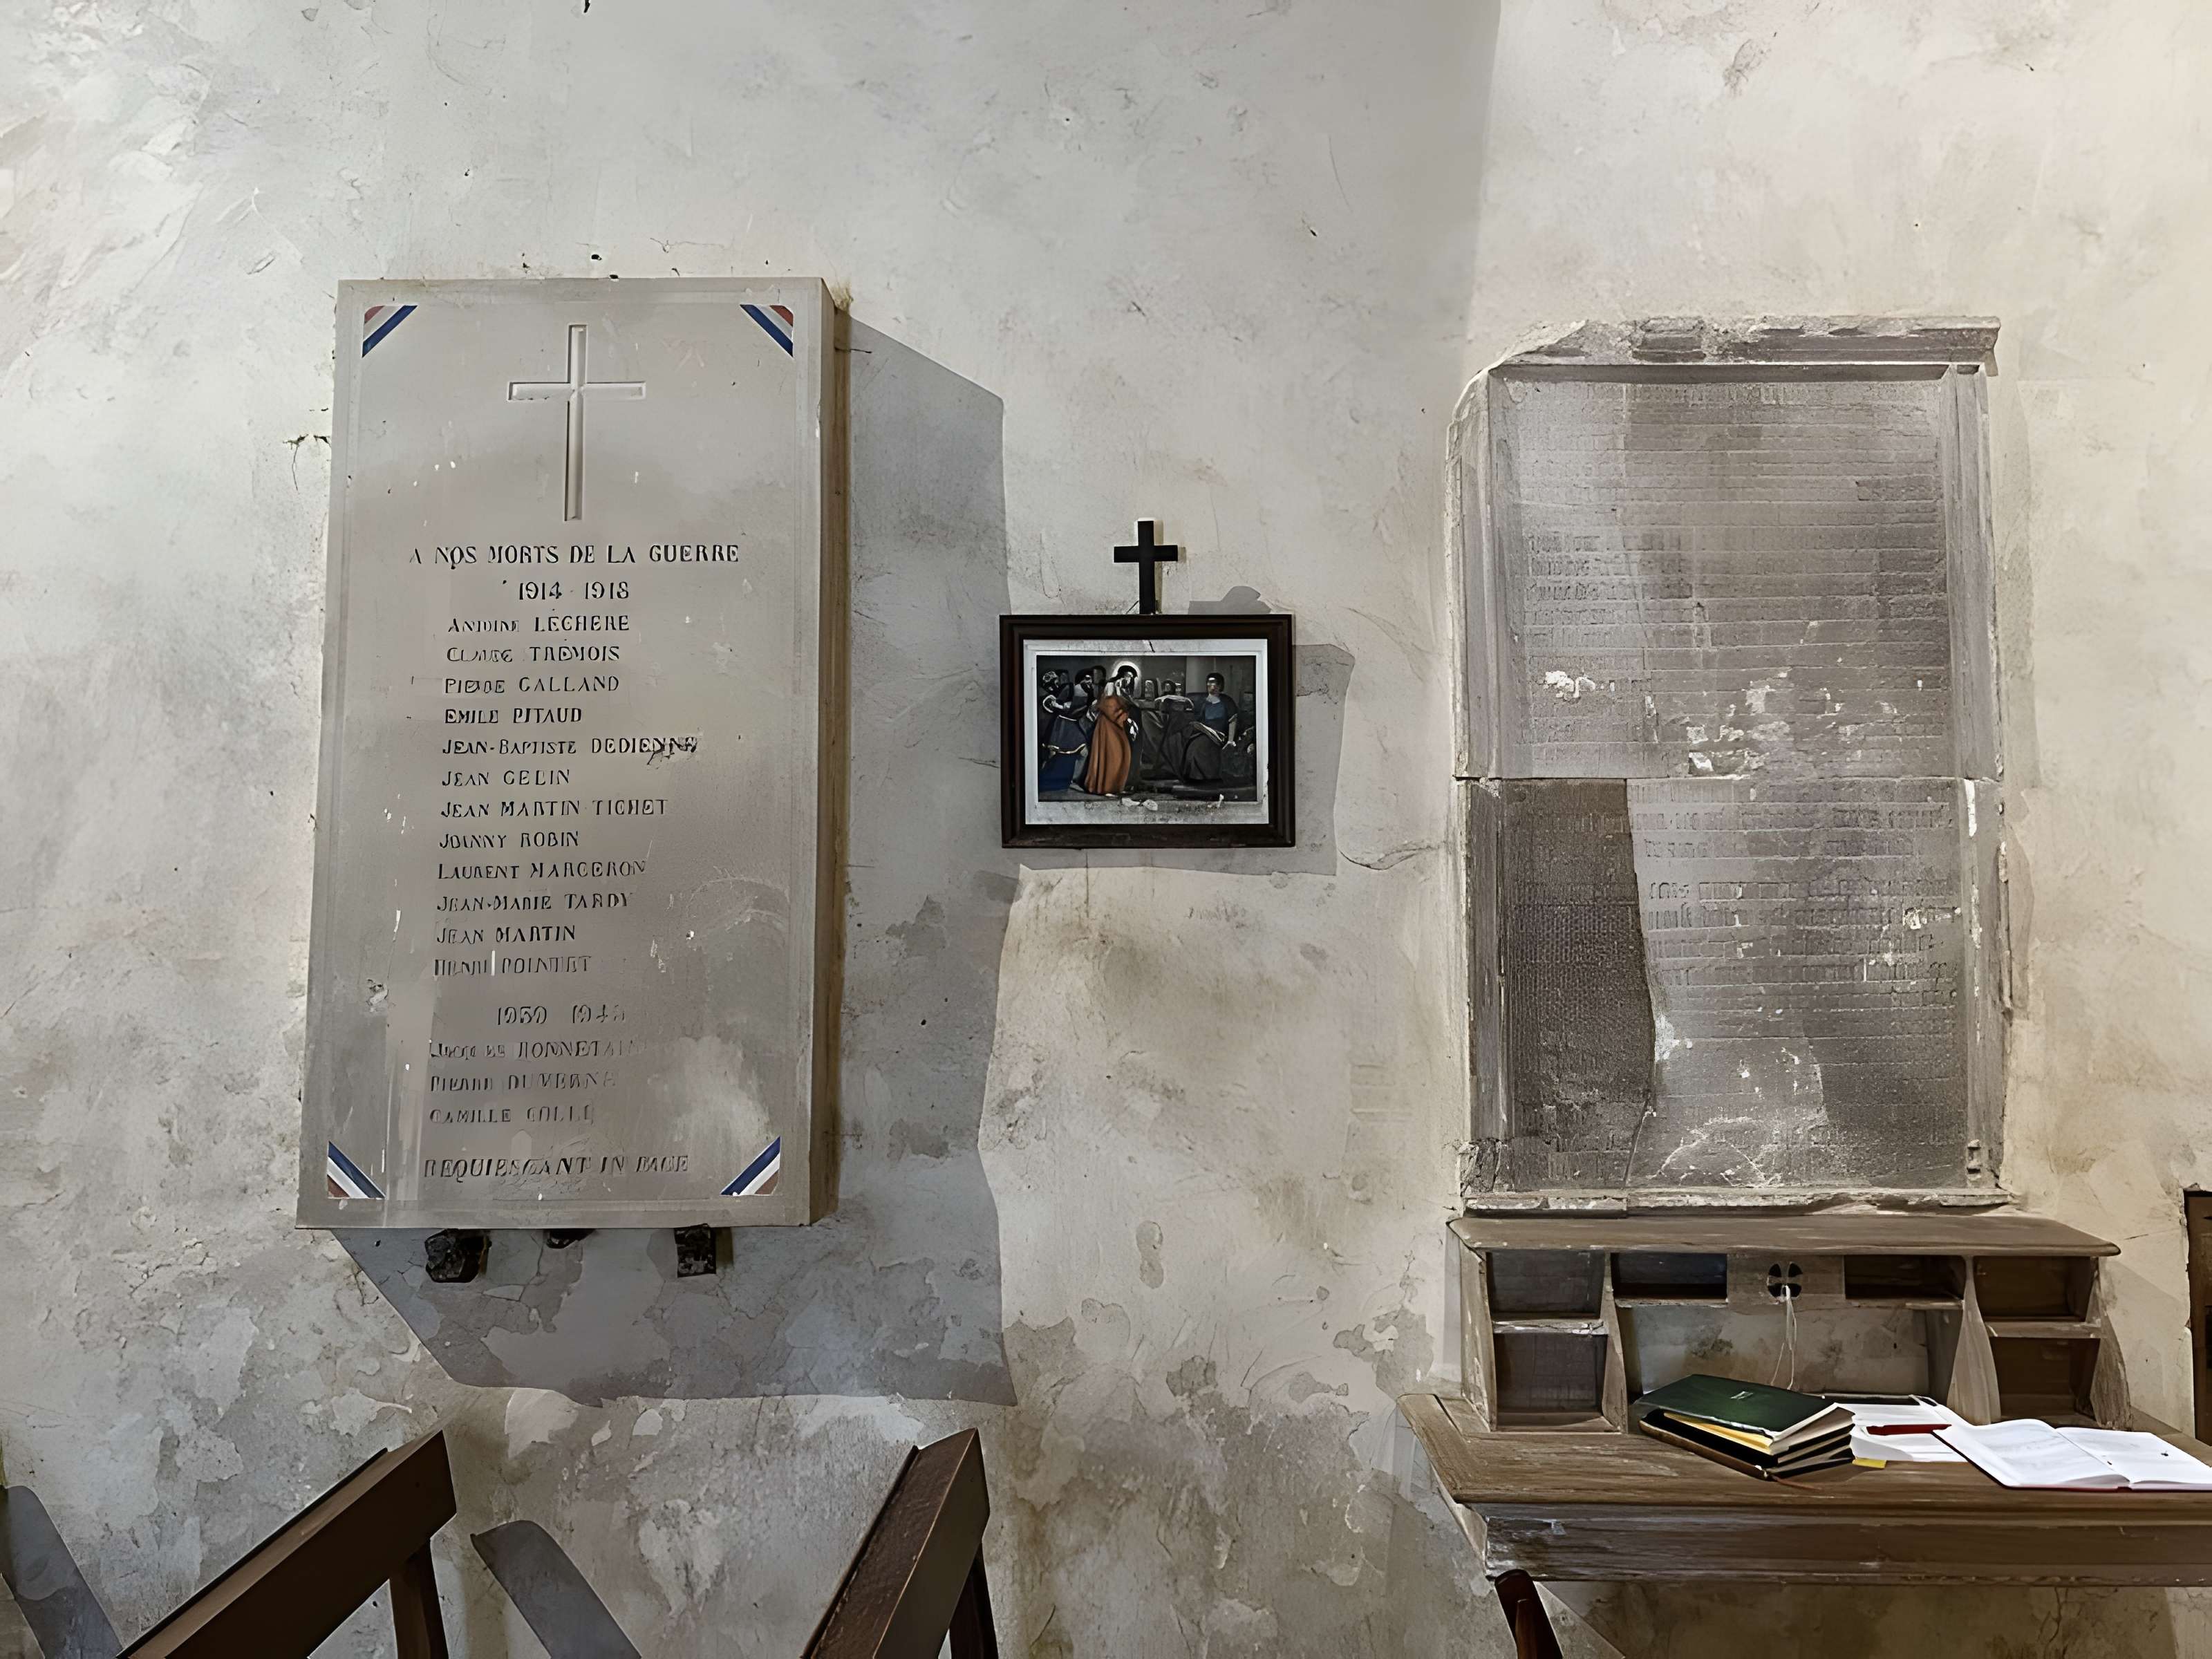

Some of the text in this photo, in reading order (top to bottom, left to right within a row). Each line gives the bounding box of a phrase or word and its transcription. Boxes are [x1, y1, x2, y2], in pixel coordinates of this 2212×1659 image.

[435, 545, 477, 565] NOS
[488, 545, 559, 564] MORTS
[570, 545, 595, 563] DE
[607, 545, 636, 563] LA
[649, 543, 739, 563] GUERRE
[519, 581, 629, 600] 1914 1918
[444, 709, 498, 724] EMILE
[442, 739, 577, 754] JEAN-BAPTISTE
[442, 770, 489, 787] JEAN
[441, 802, 489, 818] JEAN
[501, 800, 580, 817] MARTIN
[521, 831, 579, 847] ROBIN
[438, 863, 520, 879] LAURENT
[437, 895, 552, 911] JEAN-MARIE
[437, 926, 575, 944] JEAN MARTIN
